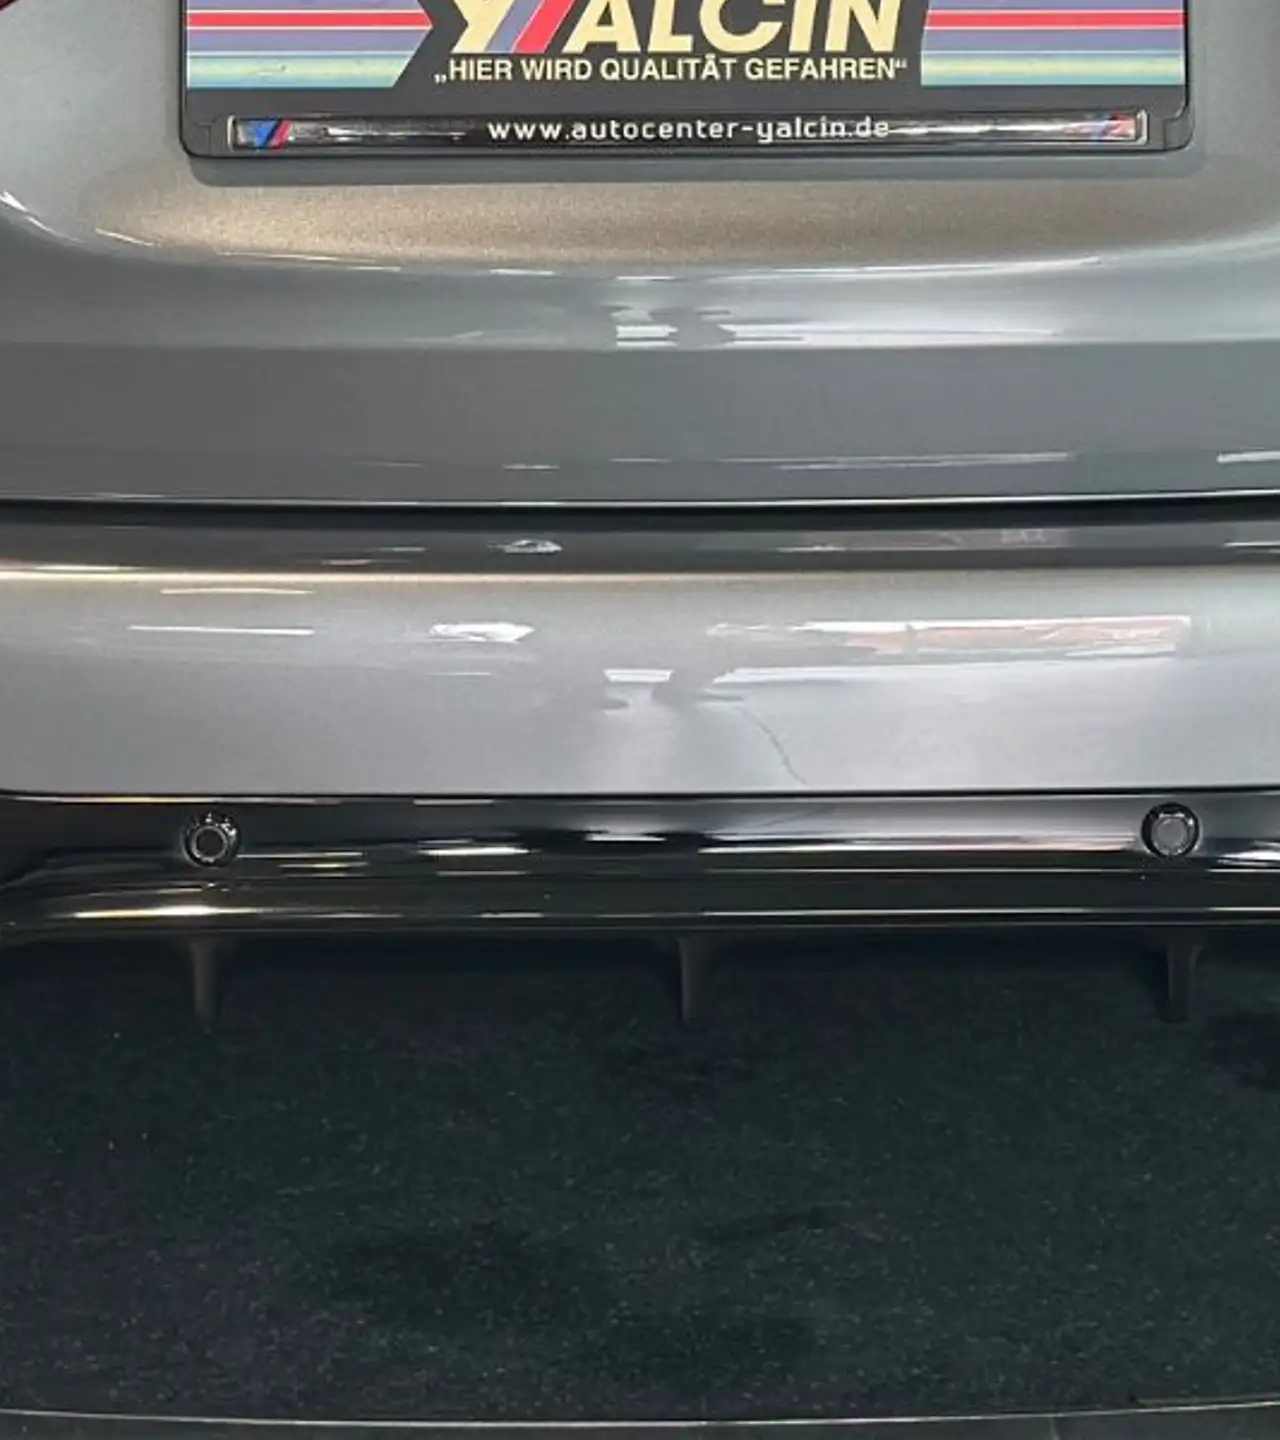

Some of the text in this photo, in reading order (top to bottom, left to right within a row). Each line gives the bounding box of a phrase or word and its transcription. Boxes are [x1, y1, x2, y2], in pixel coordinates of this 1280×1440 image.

[522, 59, 592, 80] WIRD
[600, 54, 737, 81] QUALITÄT
[487, 116, 889, 143] www.autocenter-yalcin.de
